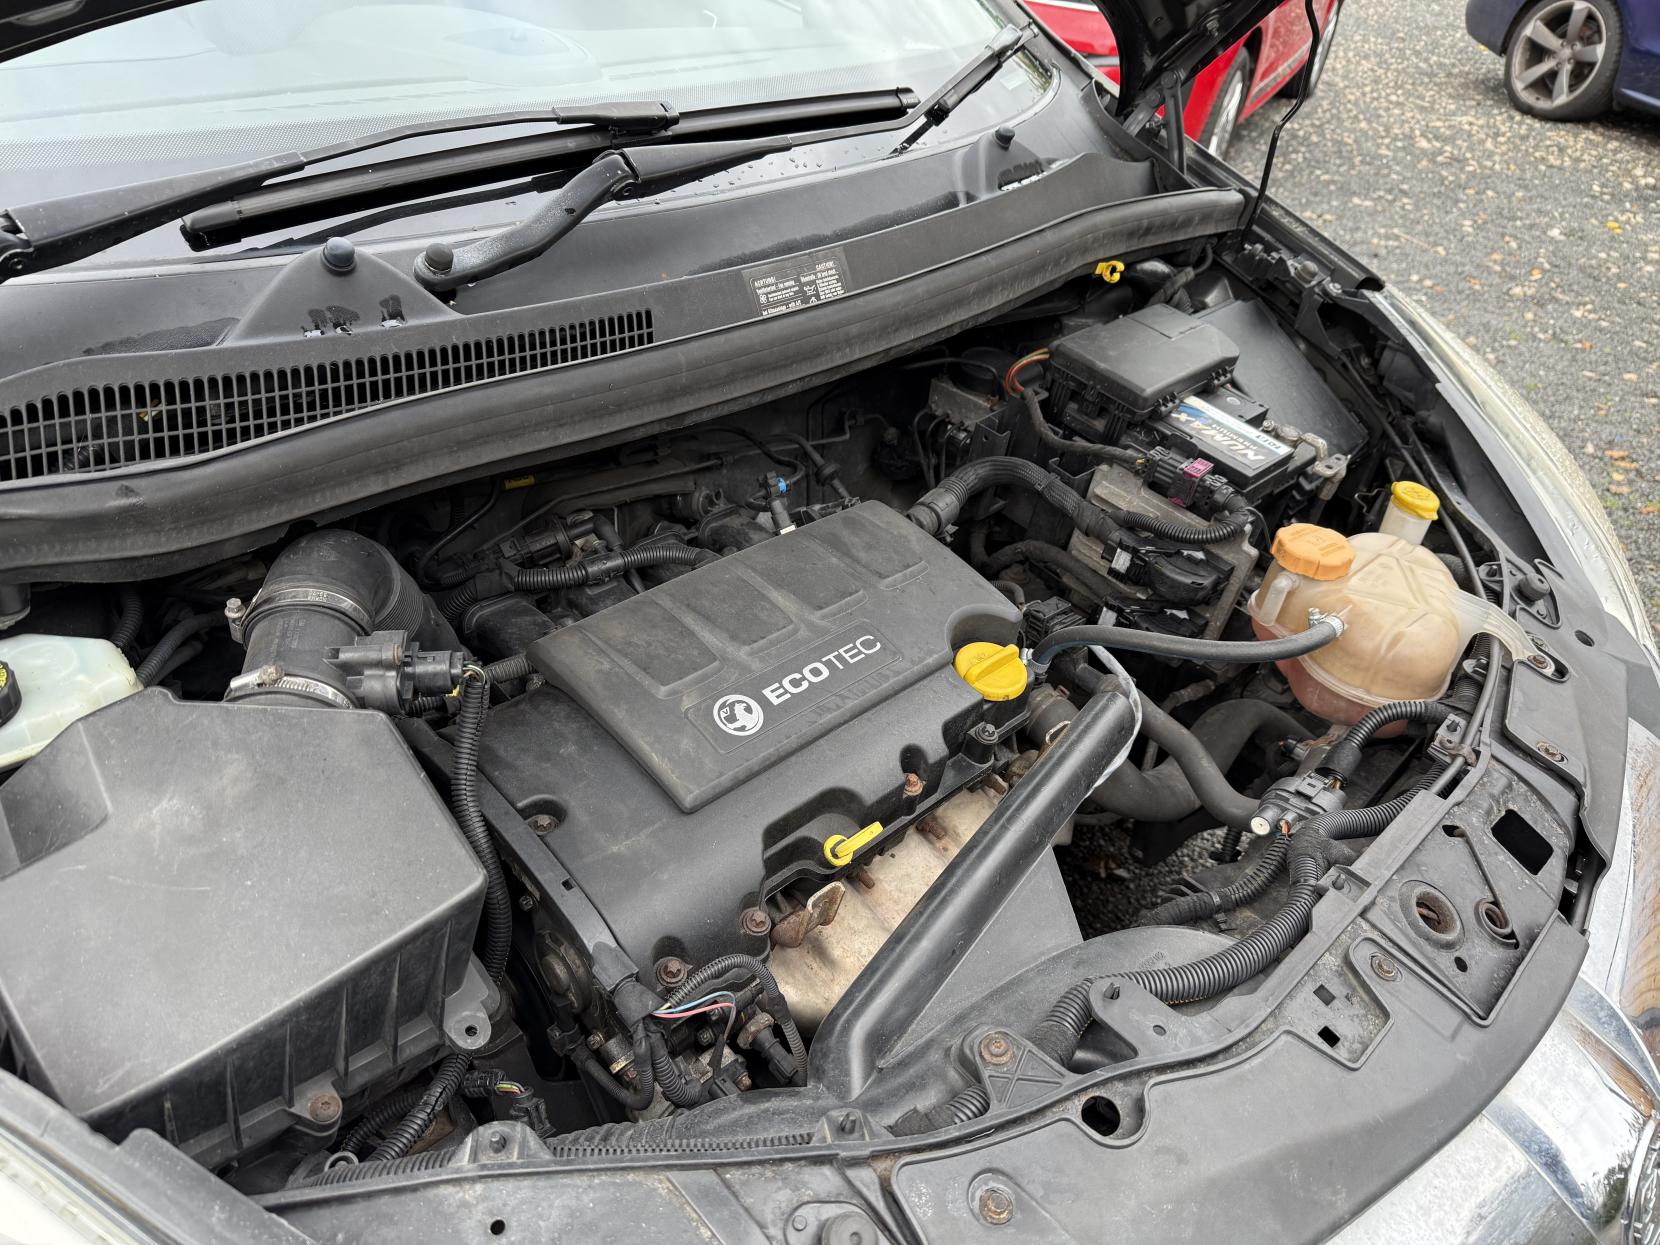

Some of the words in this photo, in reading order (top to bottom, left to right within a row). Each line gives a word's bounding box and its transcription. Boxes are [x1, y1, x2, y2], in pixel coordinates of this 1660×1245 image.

[1171, 413, 1266, 461] NUMAX
[1211, 423, 1258, 450] PREMIUM
[761, 635, 881, 706] ECOTEC
